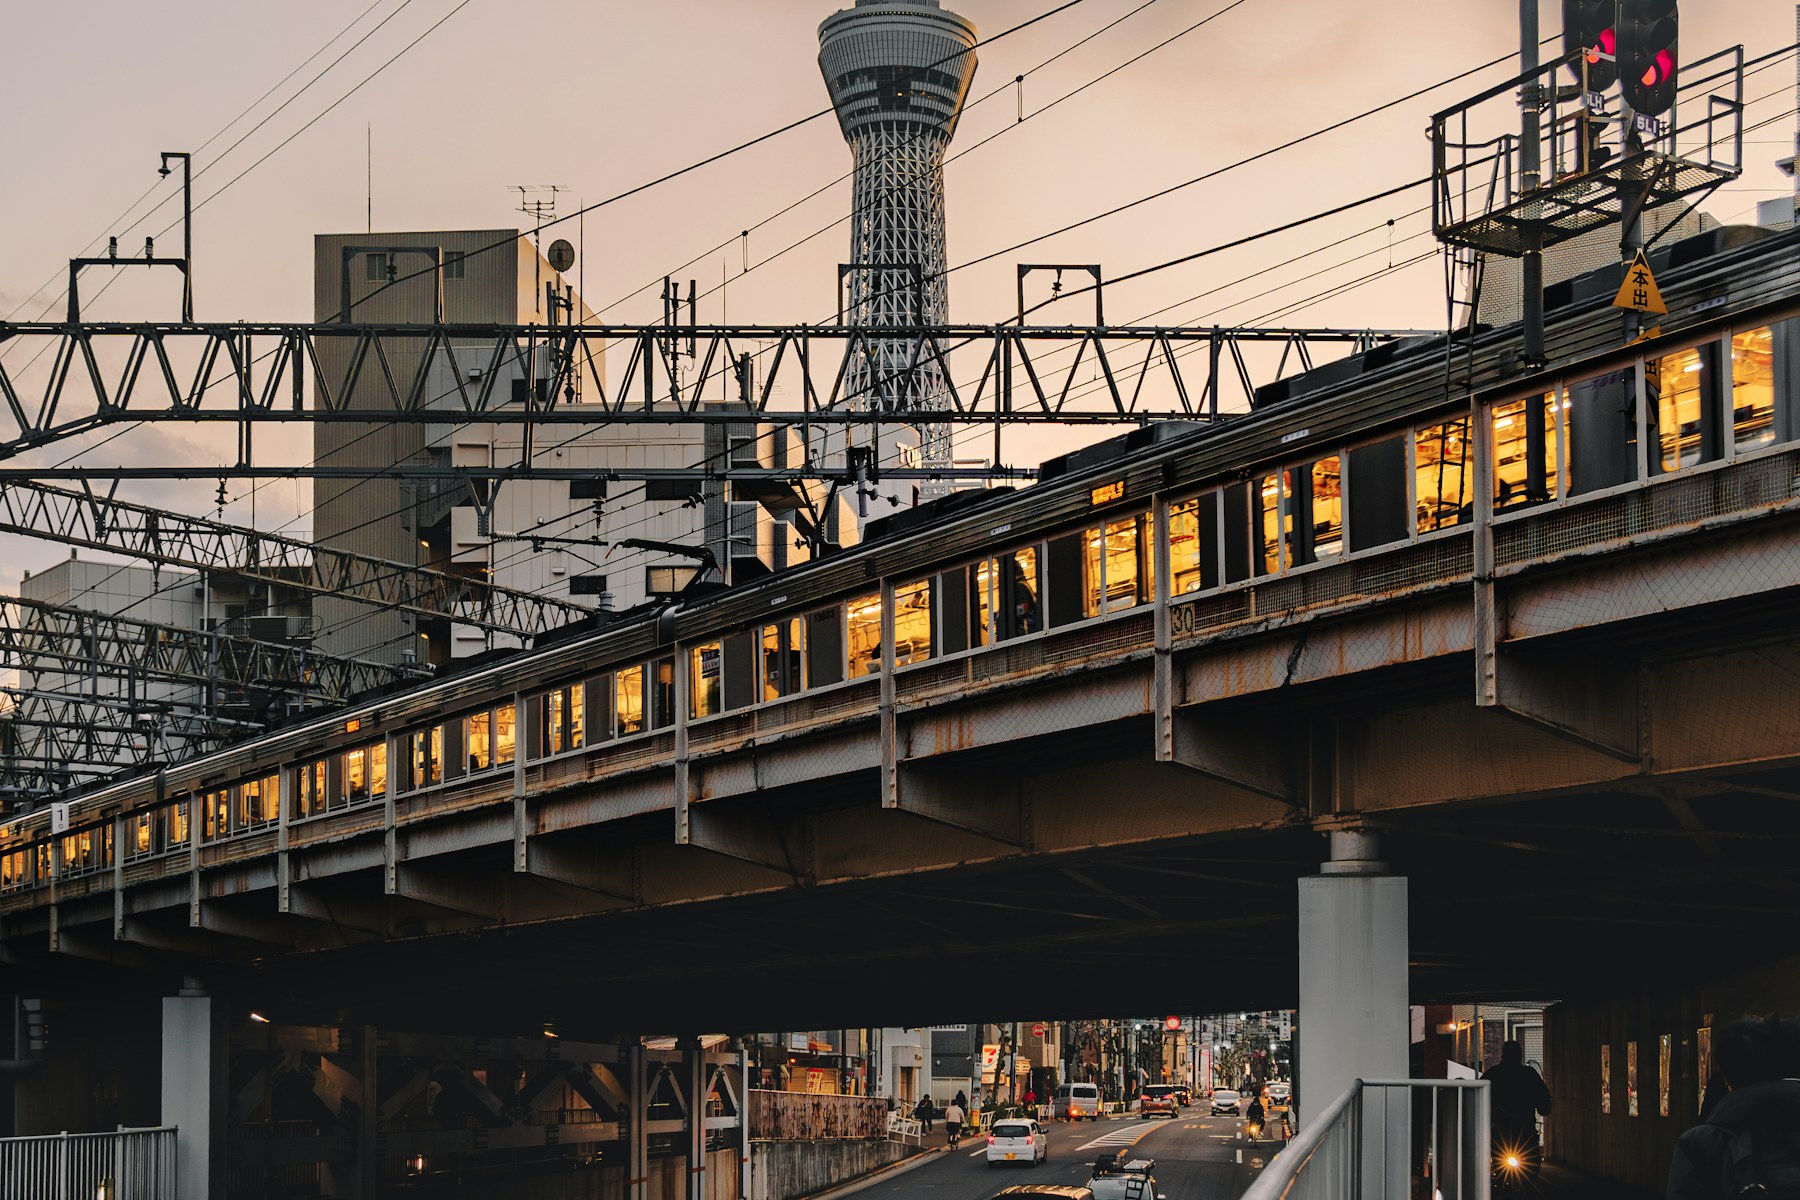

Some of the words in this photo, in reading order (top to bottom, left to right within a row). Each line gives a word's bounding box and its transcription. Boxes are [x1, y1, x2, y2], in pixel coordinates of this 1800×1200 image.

[1632, 269, 1648, 308] 本出
[1174, 607, 1193, 632] 30
[57, 809, 63, 821] 1
